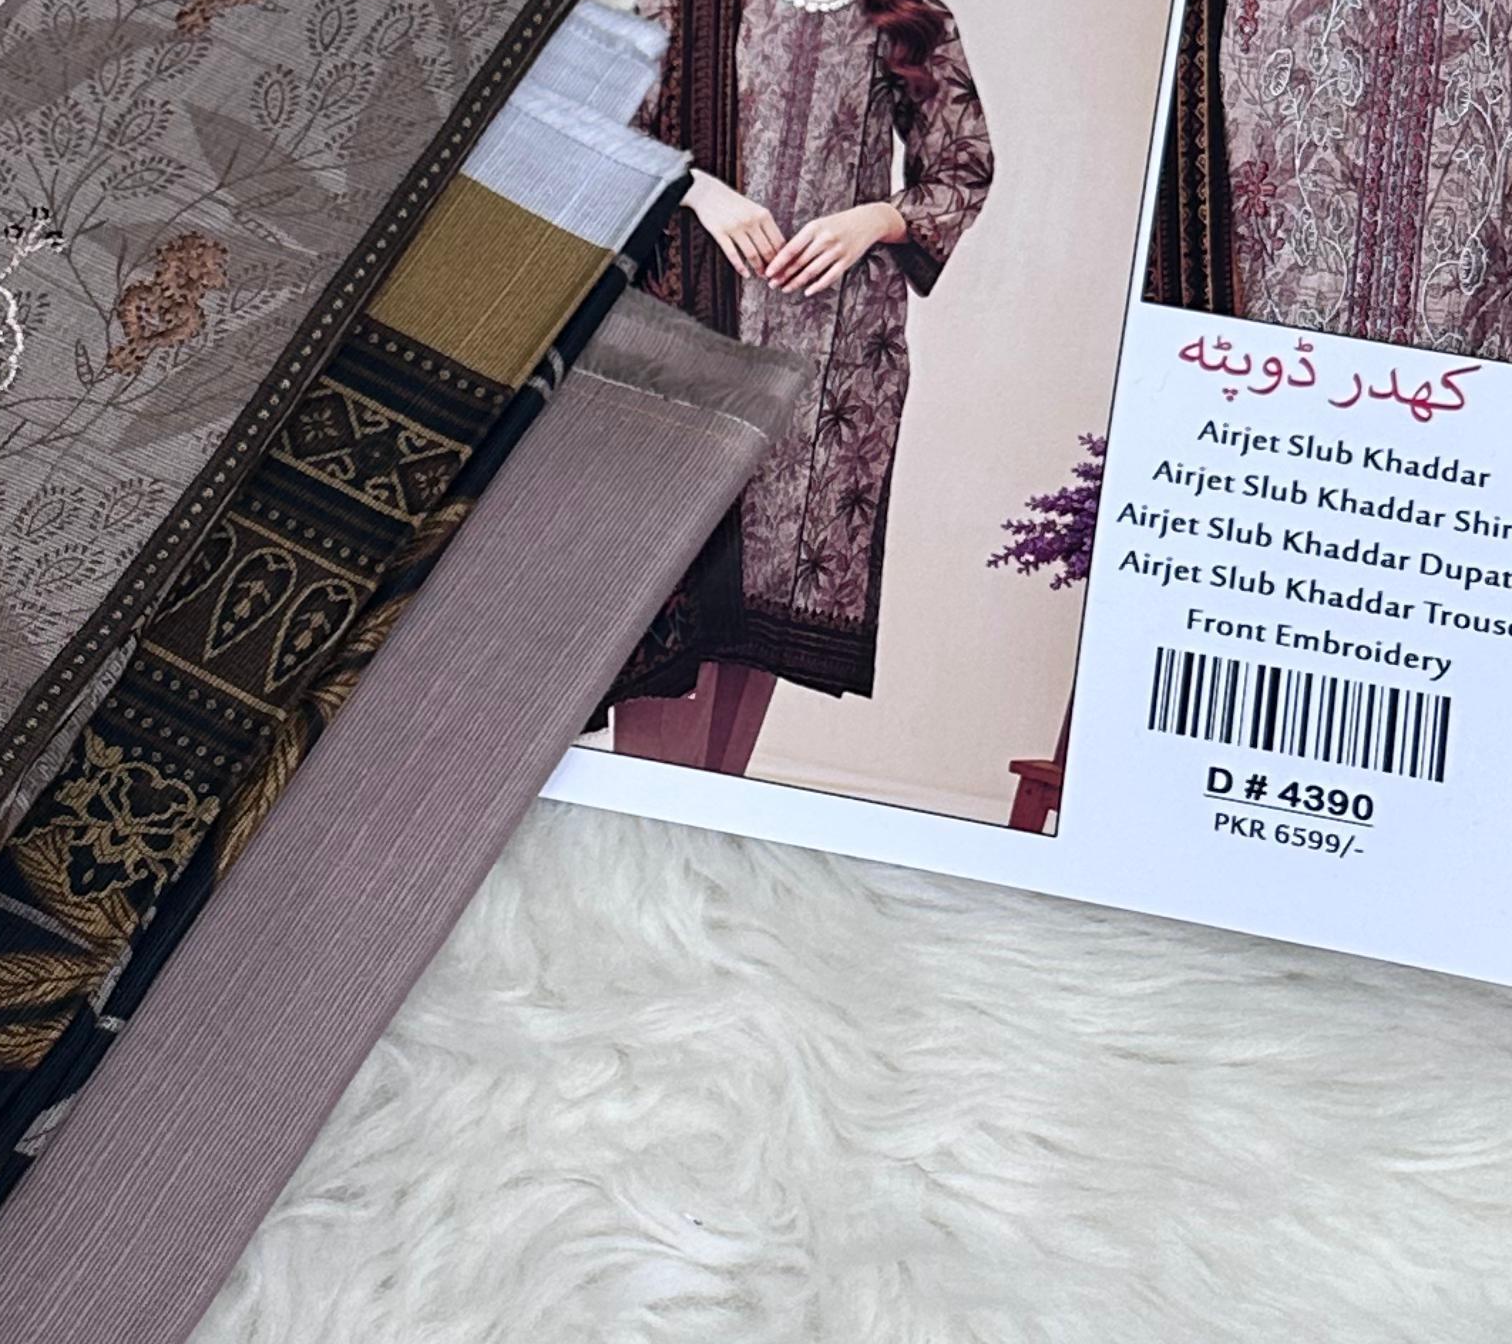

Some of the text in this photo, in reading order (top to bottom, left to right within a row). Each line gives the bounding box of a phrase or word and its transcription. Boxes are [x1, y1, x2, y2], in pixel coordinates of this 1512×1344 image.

[1177, 336, 1483, 423] کھدر ڈوپٹہ
[1197, 420, 1491, 488] Airjet Slub Khaddar
[1151, 460, 1236, 497] Airjet
[1242, 474, 1308, 505] Slub
[1317, 486, 1446, 528] Khaddar
[1116, 502, 1200, 539] Airjet
[1207, 517, 1273, 548] Slub
[1282, 529, 1411, 571] Khaddar
[1118, 550, 1202, 587] Airjet
[1209, 564, 1275, 596] Slub
[1285, 577, 1416, 620] Khaddar
[1186, 608, 1452, 682] Front Embroidery
[1206, 766, 1374, 821] D # 4390
[1214, 812, 1364, 859] PKR 6599/-
